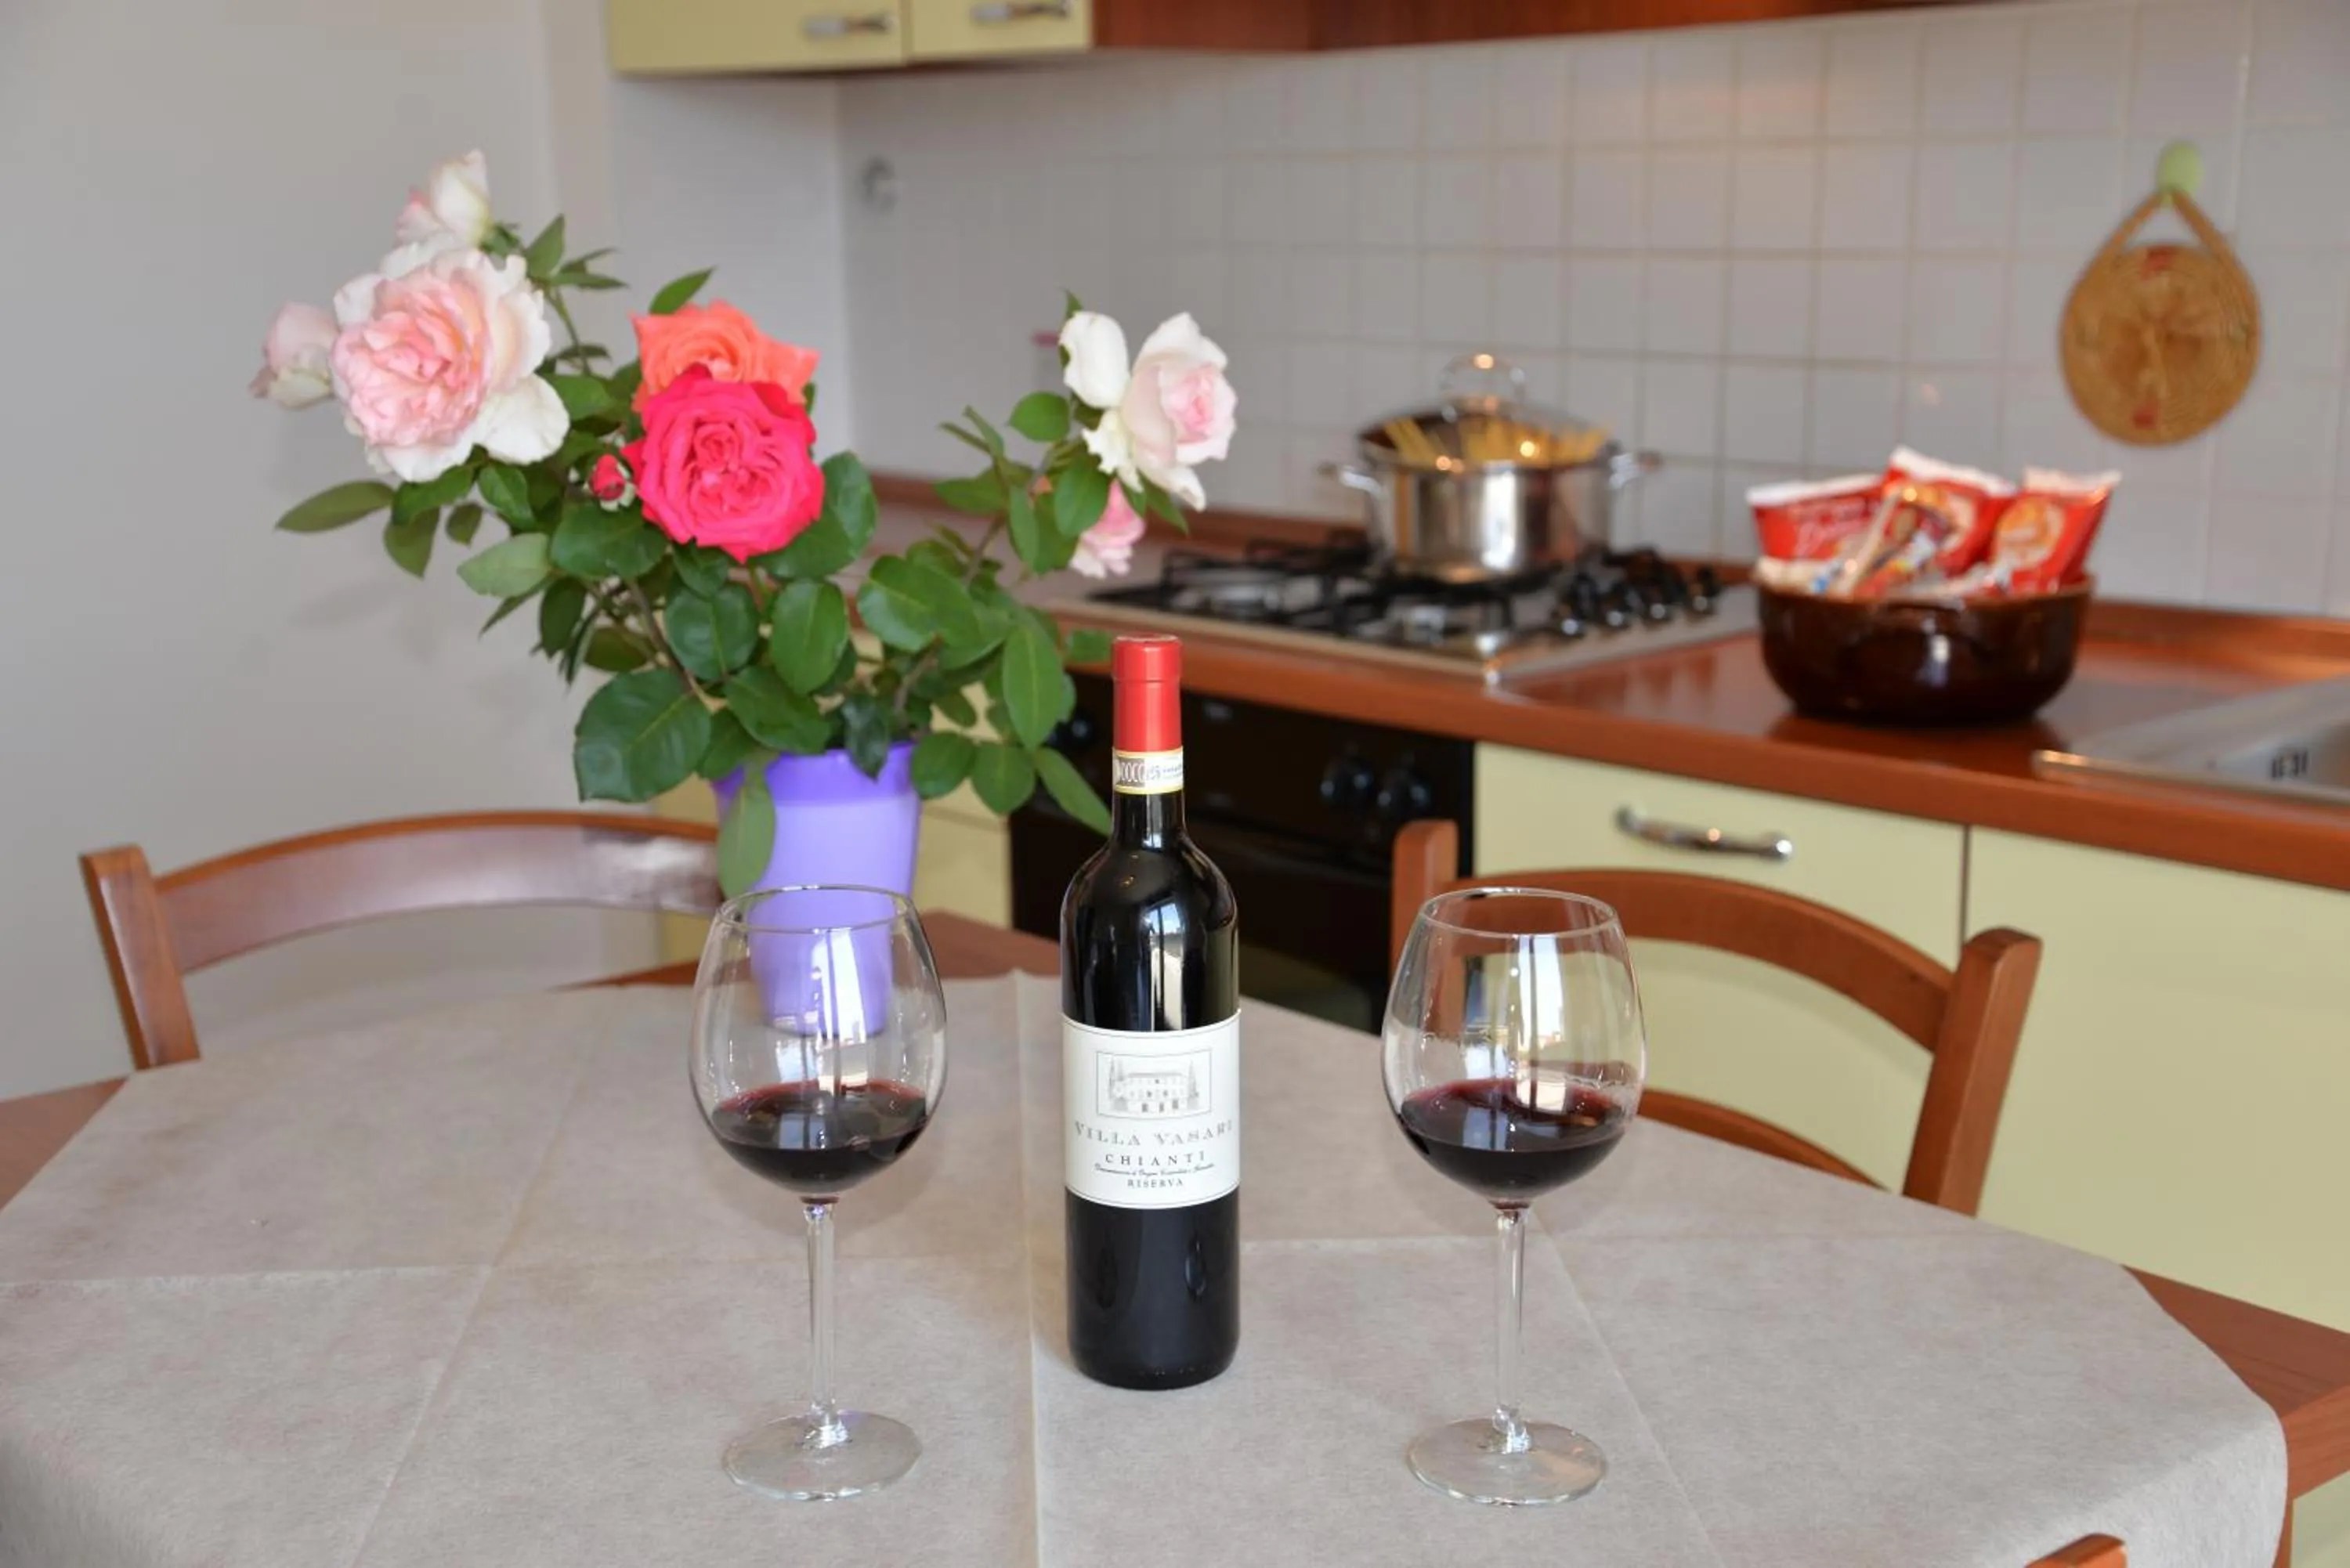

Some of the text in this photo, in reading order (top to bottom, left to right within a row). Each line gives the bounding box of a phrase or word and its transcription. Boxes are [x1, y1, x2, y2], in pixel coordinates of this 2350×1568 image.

[1074, 1119, 1233, 1146] VILLA VASARI
[1104, 1150, 1206, 1166] CHIANTI
[1126, 1179, 1184, 1189] RISERVA
